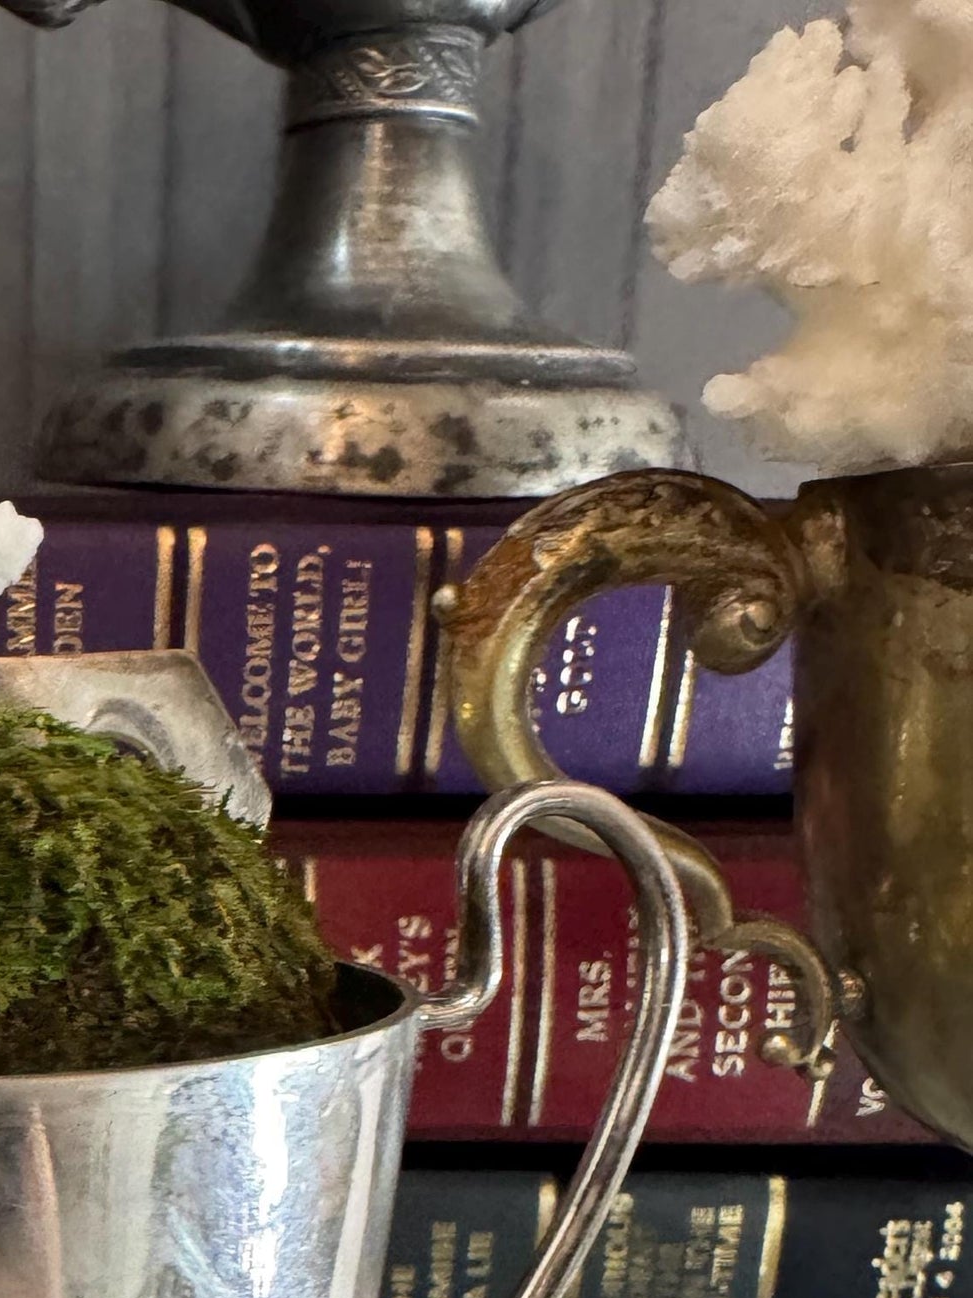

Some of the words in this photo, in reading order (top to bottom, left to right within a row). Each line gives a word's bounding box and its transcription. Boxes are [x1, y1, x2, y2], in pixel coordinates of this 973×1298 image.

[248, 542, 280, 597] TO
[287, 543, 332, 697] WORLD,
[280, 703, 316, 780] THE
[326, 671, 365, 767] BABY
[575, 950, 613, 1043] MRS.
[711, 948, 755, 1078] SECON
